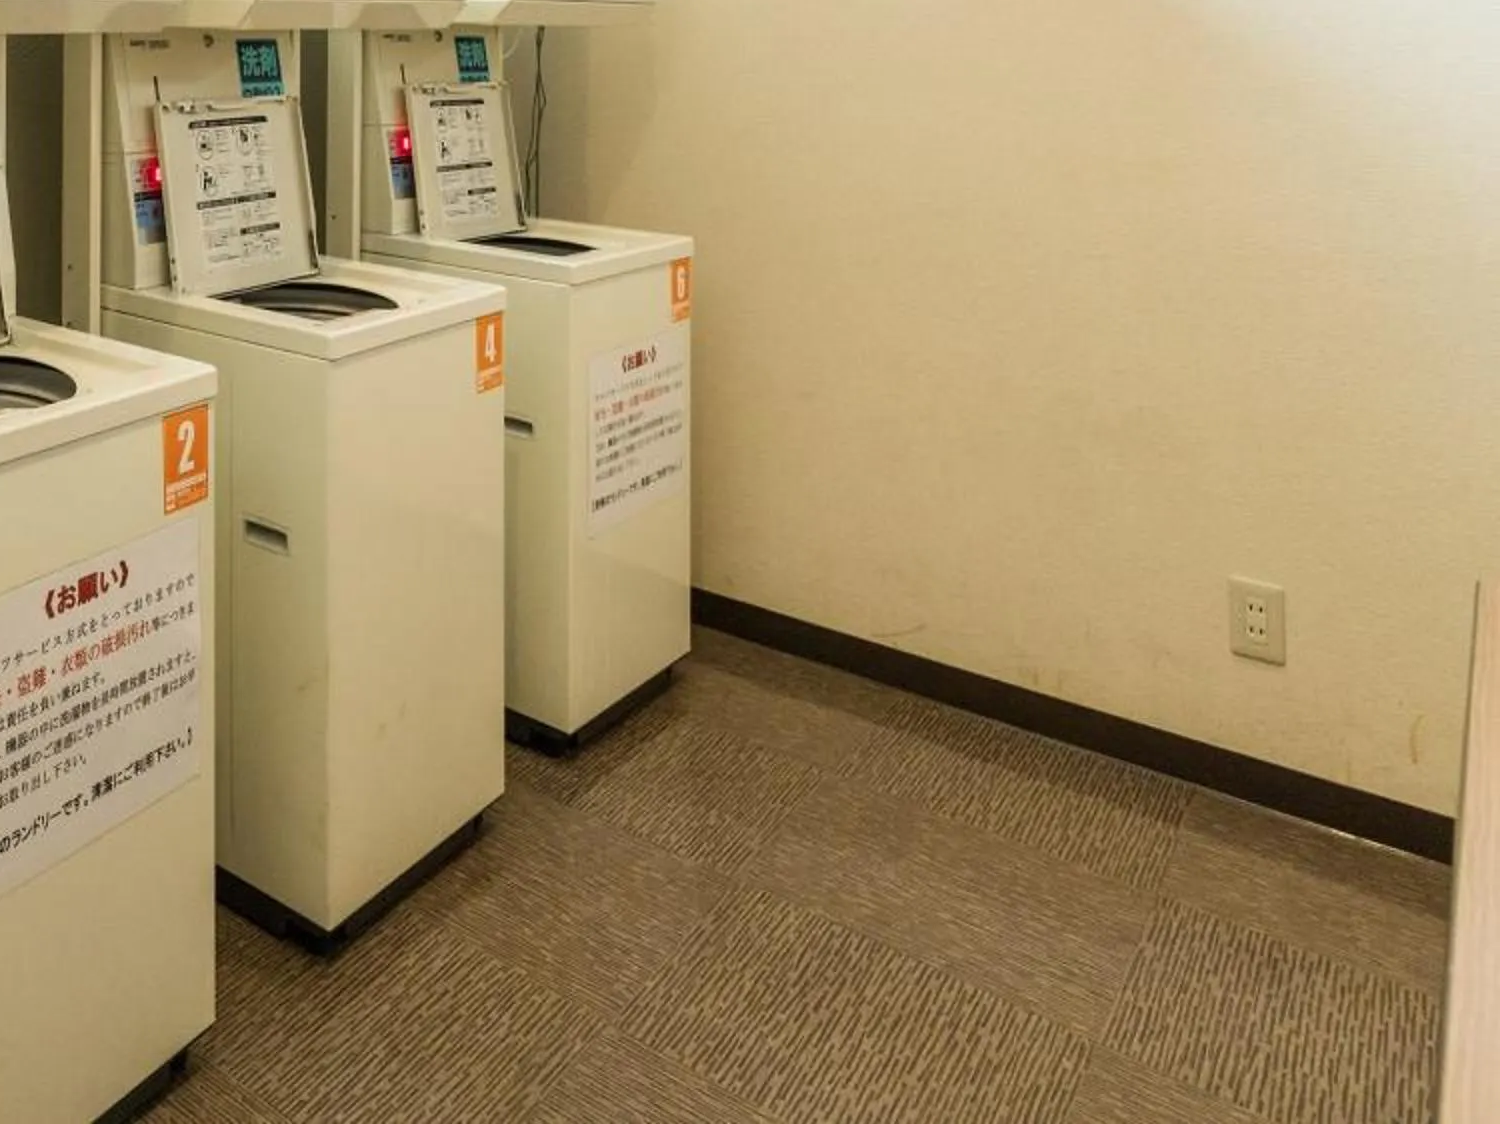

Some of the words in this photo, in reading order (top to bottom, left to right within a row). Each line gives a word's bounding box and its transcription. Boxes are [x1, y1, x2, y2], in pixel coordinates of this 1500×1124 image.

[676, 265, 686, 300] 6
[484, 322, 498, 363] 4
[178, 420, 195, 476] 2
